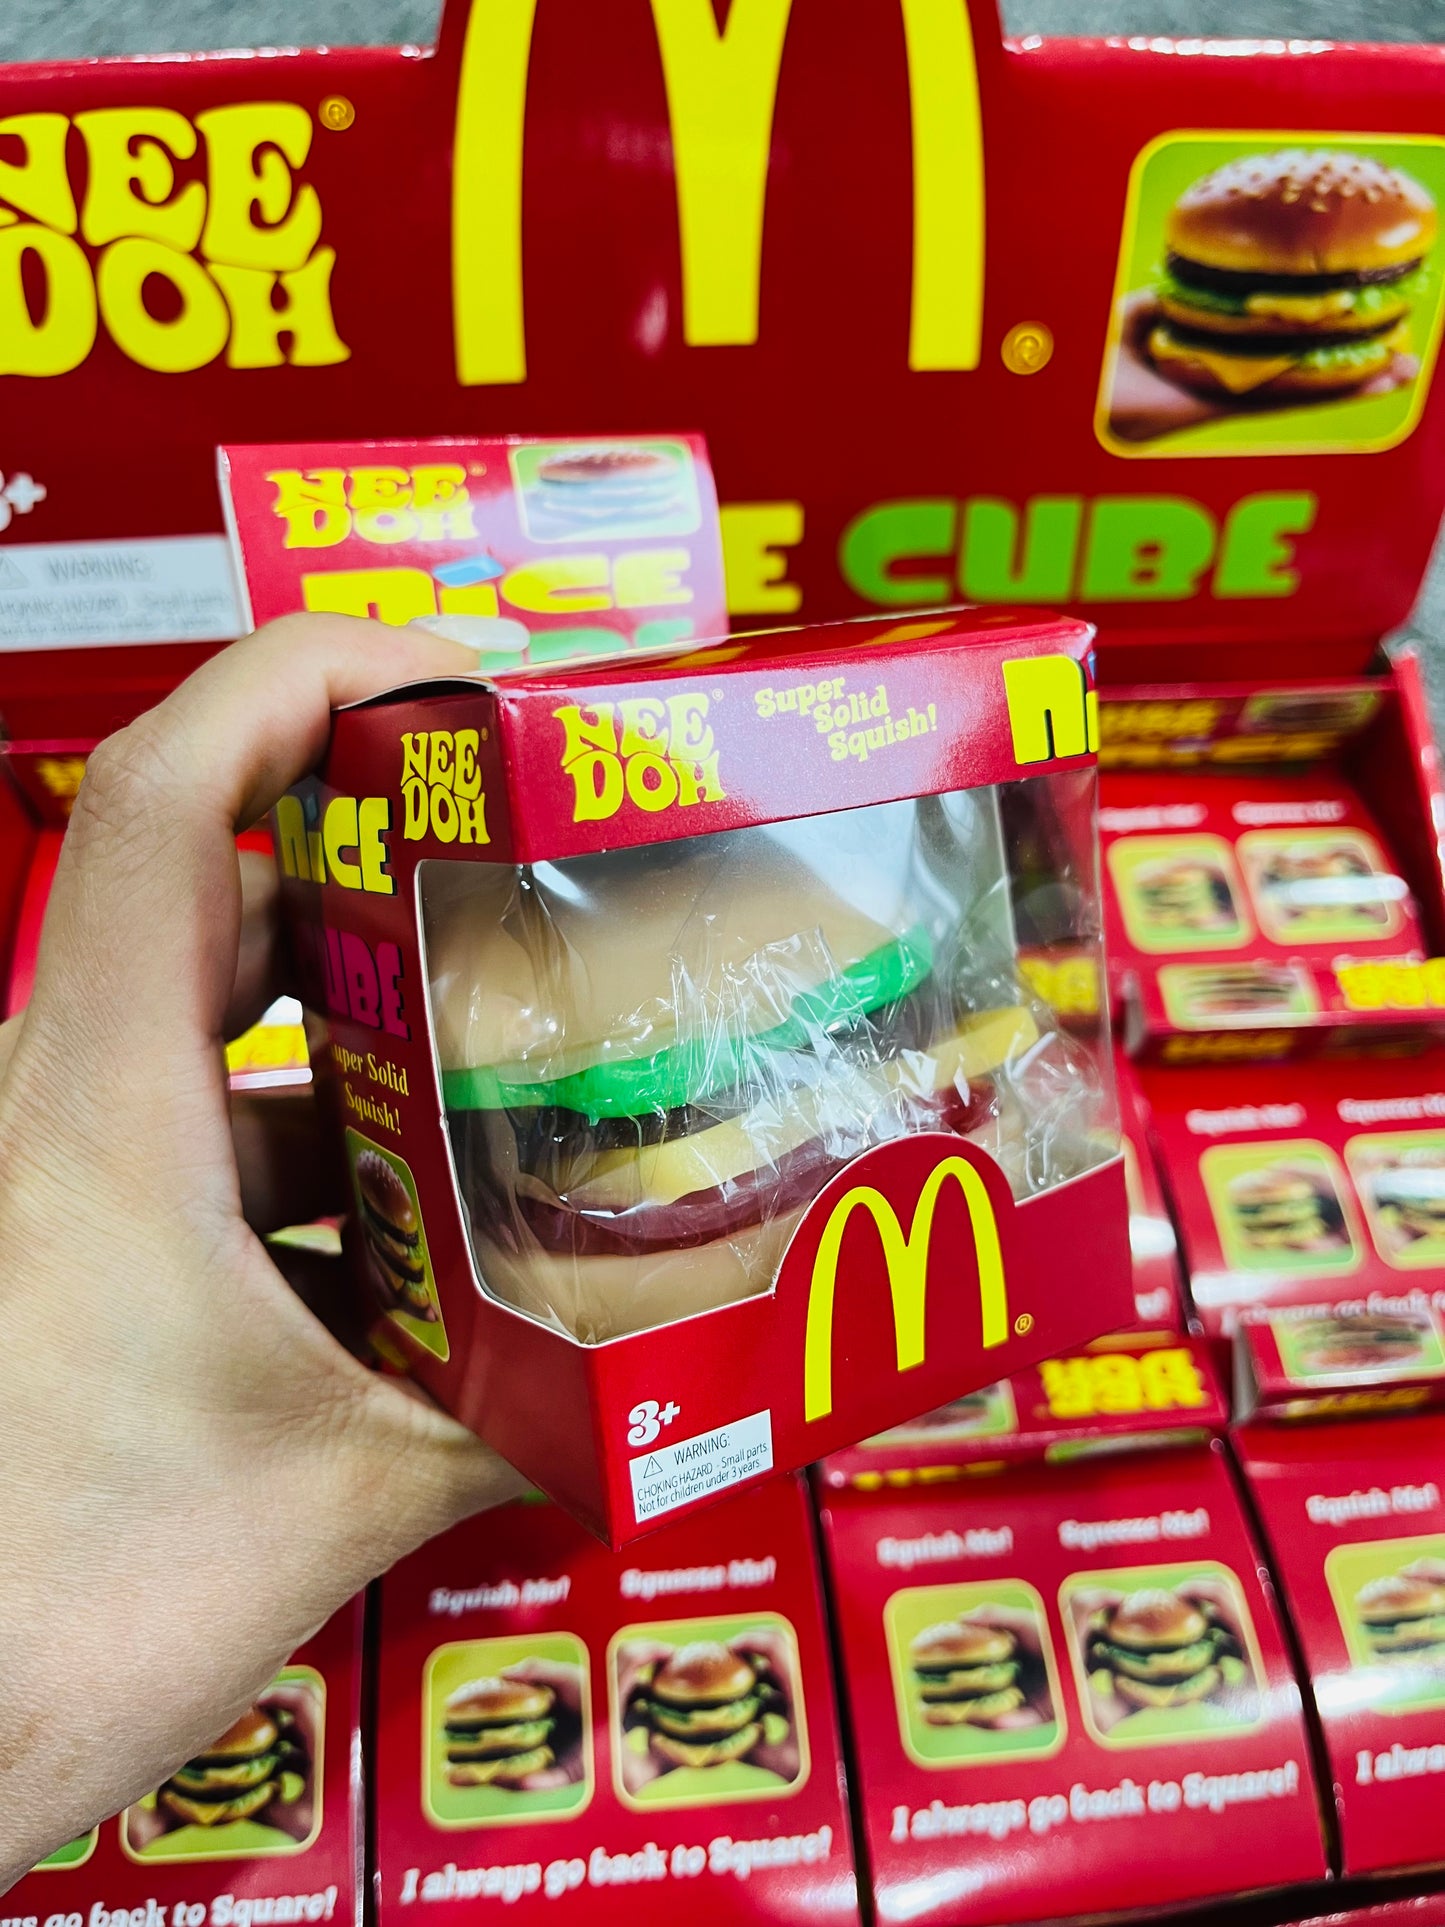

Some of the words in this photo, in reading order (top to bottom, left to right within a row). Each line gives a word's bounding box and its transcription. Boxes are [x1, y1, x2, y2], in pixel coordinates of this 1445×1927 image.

[266, 464, 469, 512] NEE
[275, 503, 480, 549] DOH
[840, 491, 1316, 605] CUBE
[755, 677, 845, 717] Super
[813, 685, 890, 733] Solid
[552, 693, 715, 767] NEE
[828, 704, 937, 762] Squish!
[401, 729, 482, 800] NEE
[565, 751, 727, 822] DOH
[401, 776, 491, 845] DOH
[331, 1044, 363, 1073] uper
[367, 1052, 409, 1096] Solid
[345, 1081, 402, 1135] Squish!
[627, 1400, 680, 1446] 3+
[674, 1432, 730, 1465] WARNING:
[637, 1476, 679, 1501] CHOKING
[679, 1462, 713, 1486] HAZARD
[721, 1448, 745, 1469] Small
[639, 1499, 656, 1515] Not
[656, 1494, 668, 1507] for
[670, 1480, 704, 1503] children
[706, 1470, 729, 1488] under
[731, 1465, 738, 1478] 3
[1374, 1742, 1445, 1782] alwa
[889, 1804, 909, 1844] I
[910, 1799, 1027, 1841] always
[1028, 1794, 1069, 1835] go
[1069, 1778, 1145, 1823] back
[1147, 1779, 1182, 1813] to
[1183, 1760, 1299, 1813] Square!
[400, 1867, 420, 1905] I
[420, 1863, 542, 1904] always
[543, 1858, 587, 1899] go
[588, 1841, 668, 1887] back
[670, 1843, 708, 1879] to
[708, 1824, 833, 1881] Square!
[88, 1897, 169, 1927] back
[171, 1899, 207, 1927] to
[209, 1884, 339, 1927] Square!
